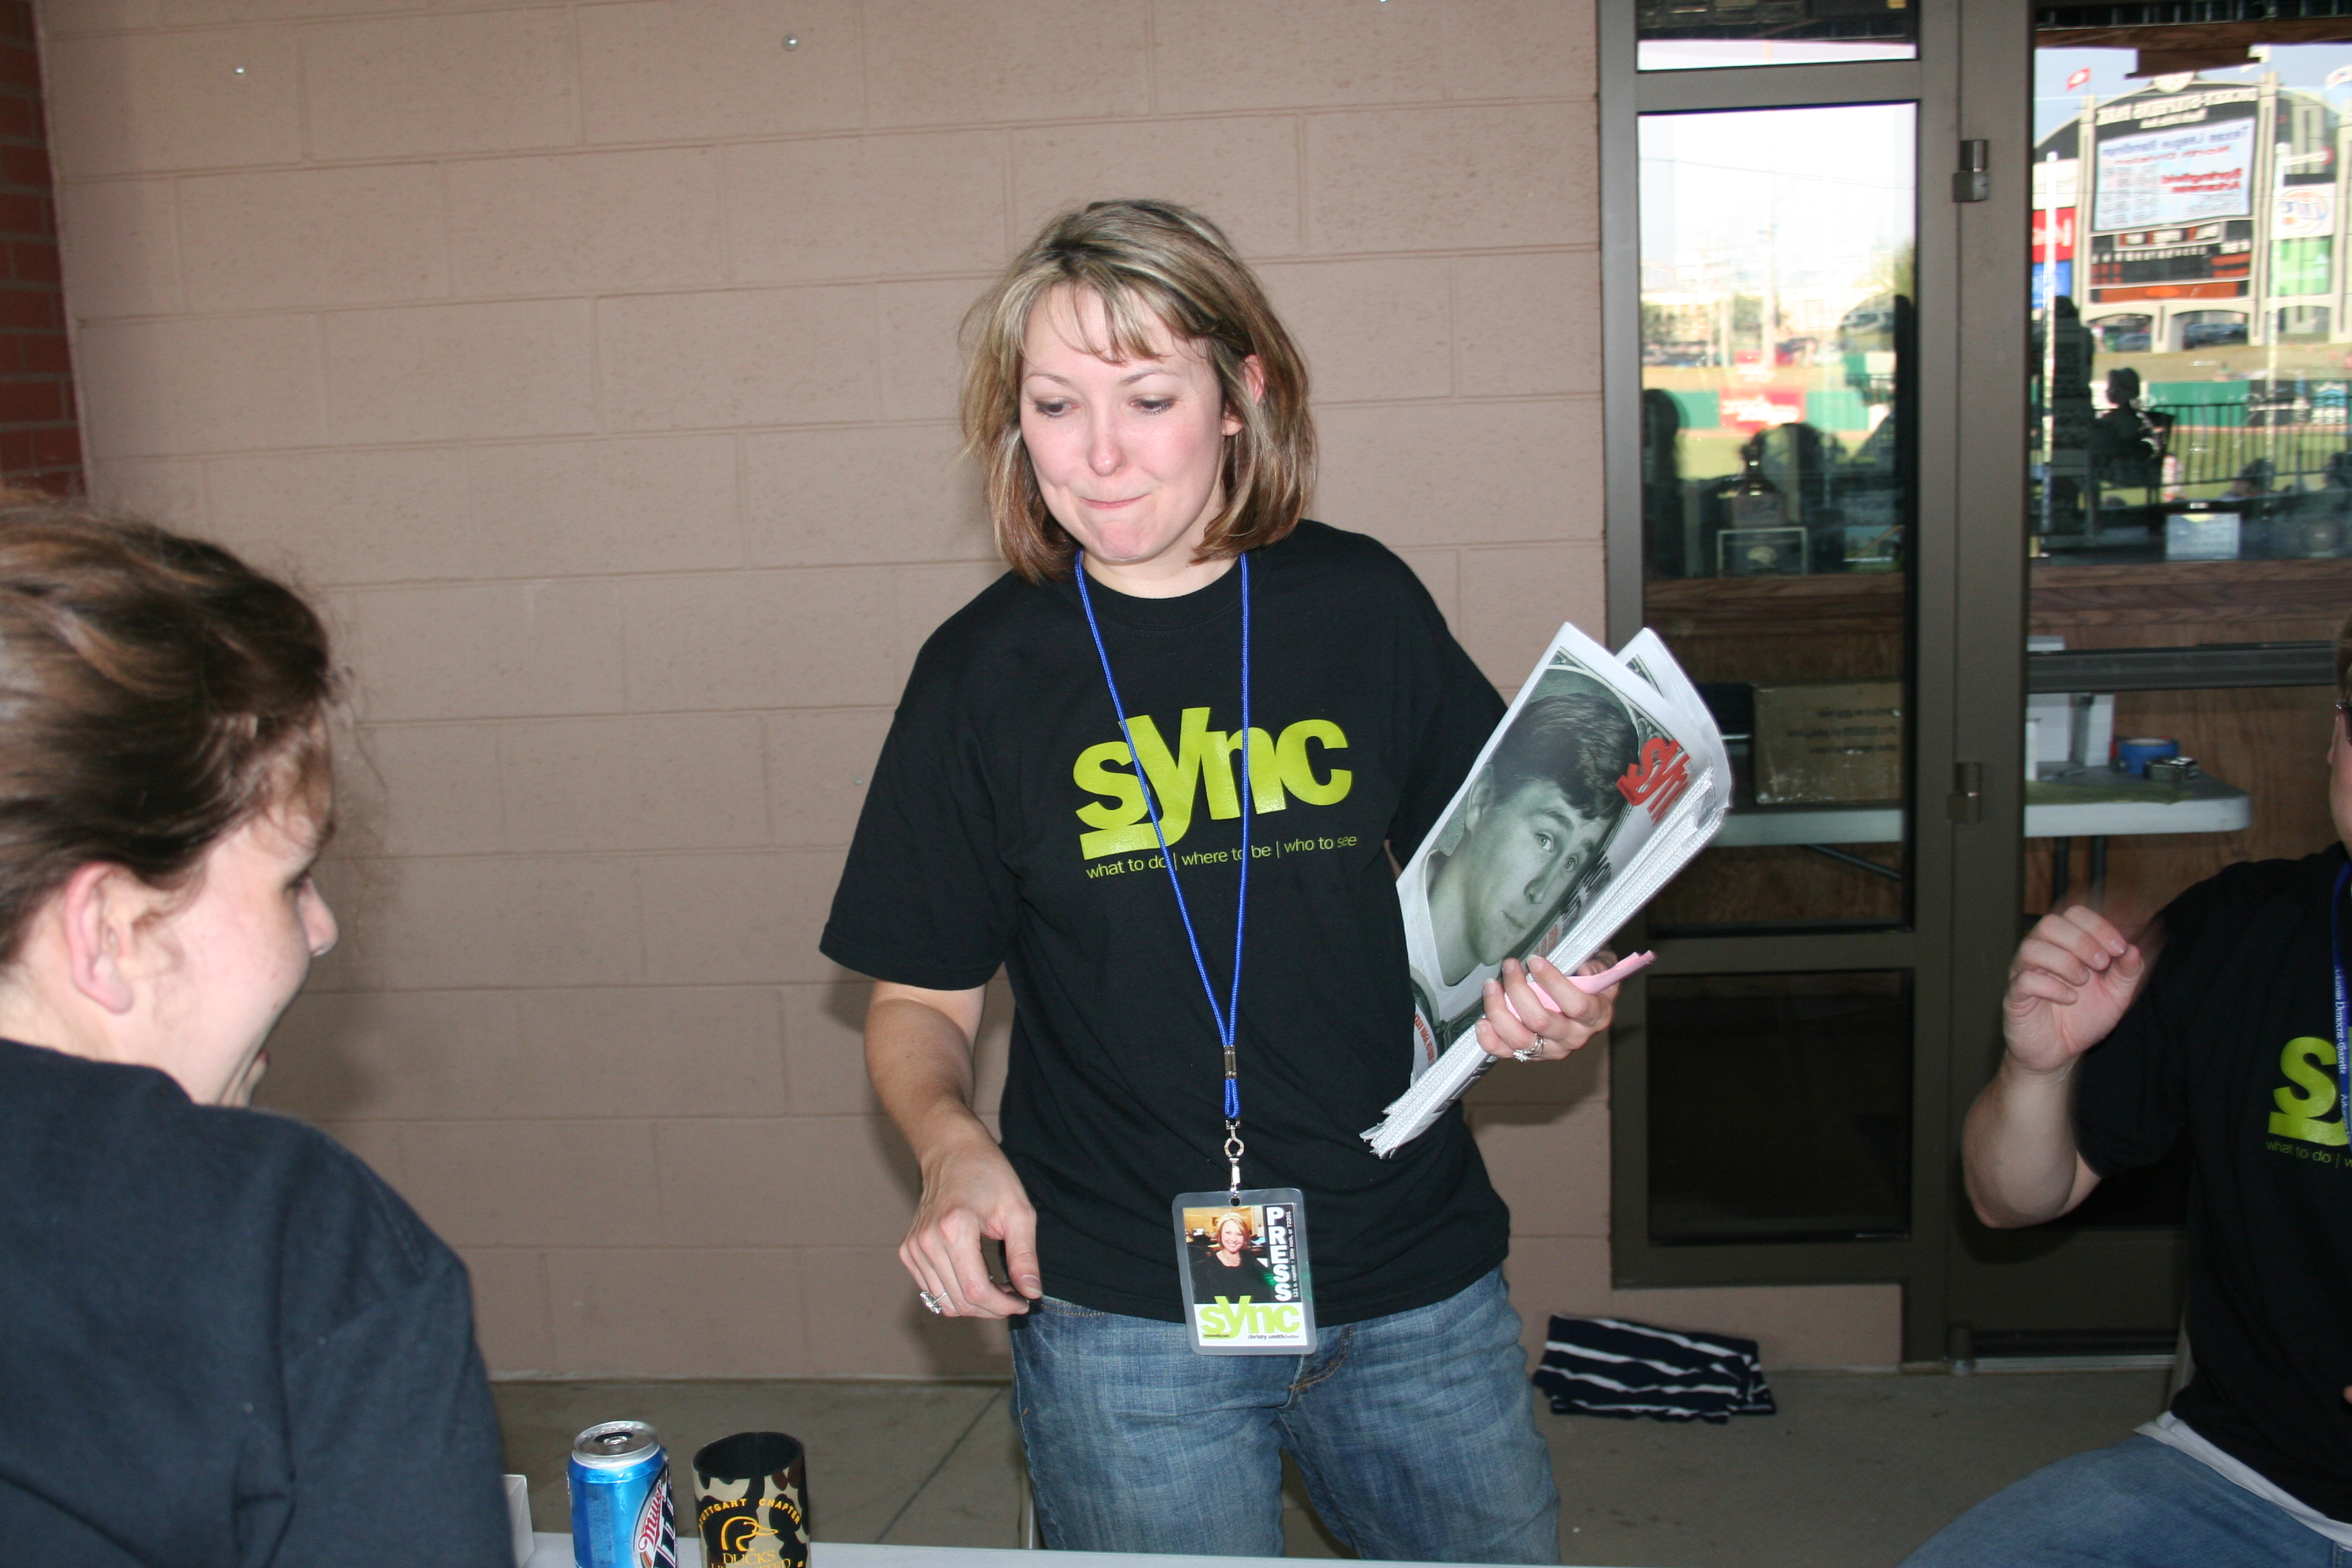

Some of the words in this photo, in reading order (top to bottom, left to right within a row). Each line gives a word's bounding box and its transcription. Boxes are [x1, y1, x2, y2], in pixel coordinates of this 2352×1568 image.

[1085, 860, 1125, 879] what
[1128, 859, 1144, 872] to
[1148, 855, 1167, 870] do
[1181, 851, 1228, 866] where
[1251, 845, 1271, 858] be
[1284, 838, 1315, 853] who
[1318, 836, 1334, 850] to
[1337, 836, 1358, 848] see
[2266, 1141, 2293, 1155] what
[2296, 1147, 2309, 1158] to
[2313, 1150, 2332, 1163] do
[1266, 1207, 1292, 1301] PRESS
[637, 1478, 664, 1553] Miller
[758, 1498, 802, 1525] CHAPTER
[722, 1549, 777, 1565] DUCKS
